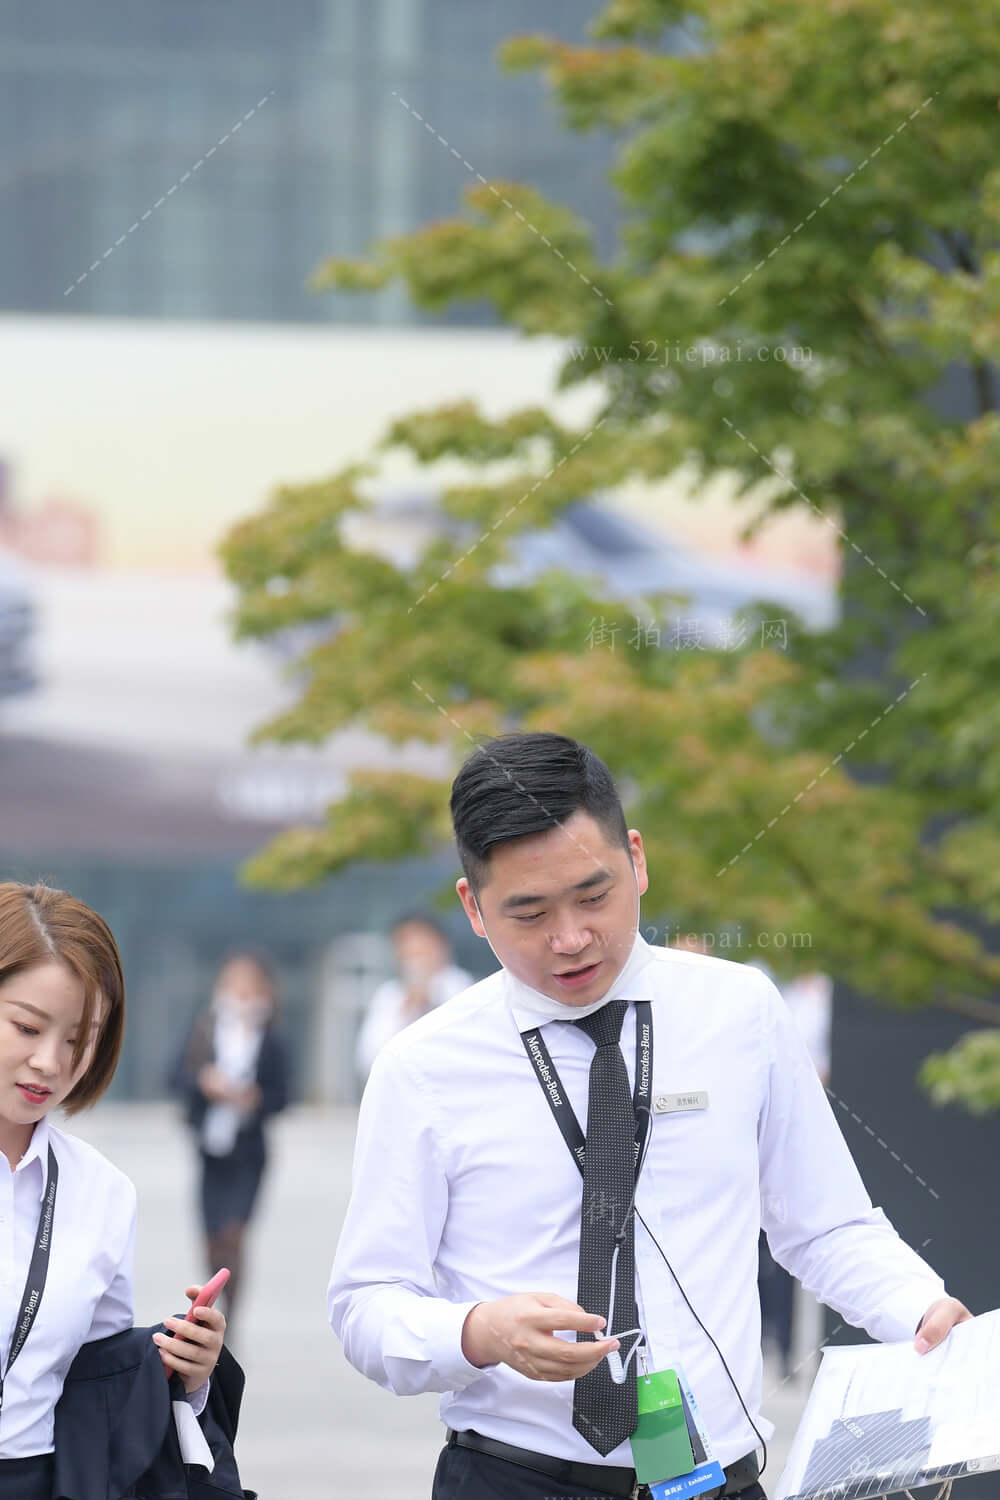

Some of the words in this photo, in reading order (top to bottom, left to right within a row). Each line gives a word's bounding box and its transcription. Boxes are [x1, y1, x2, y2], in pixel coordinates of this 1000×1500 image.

[527, 1035, 562, 1107] Mercedes-Benz
[638, 1023, 650, 1098] Mercedes-Benz
[9, 1290, 40, 1363] Mercedes-Benz
